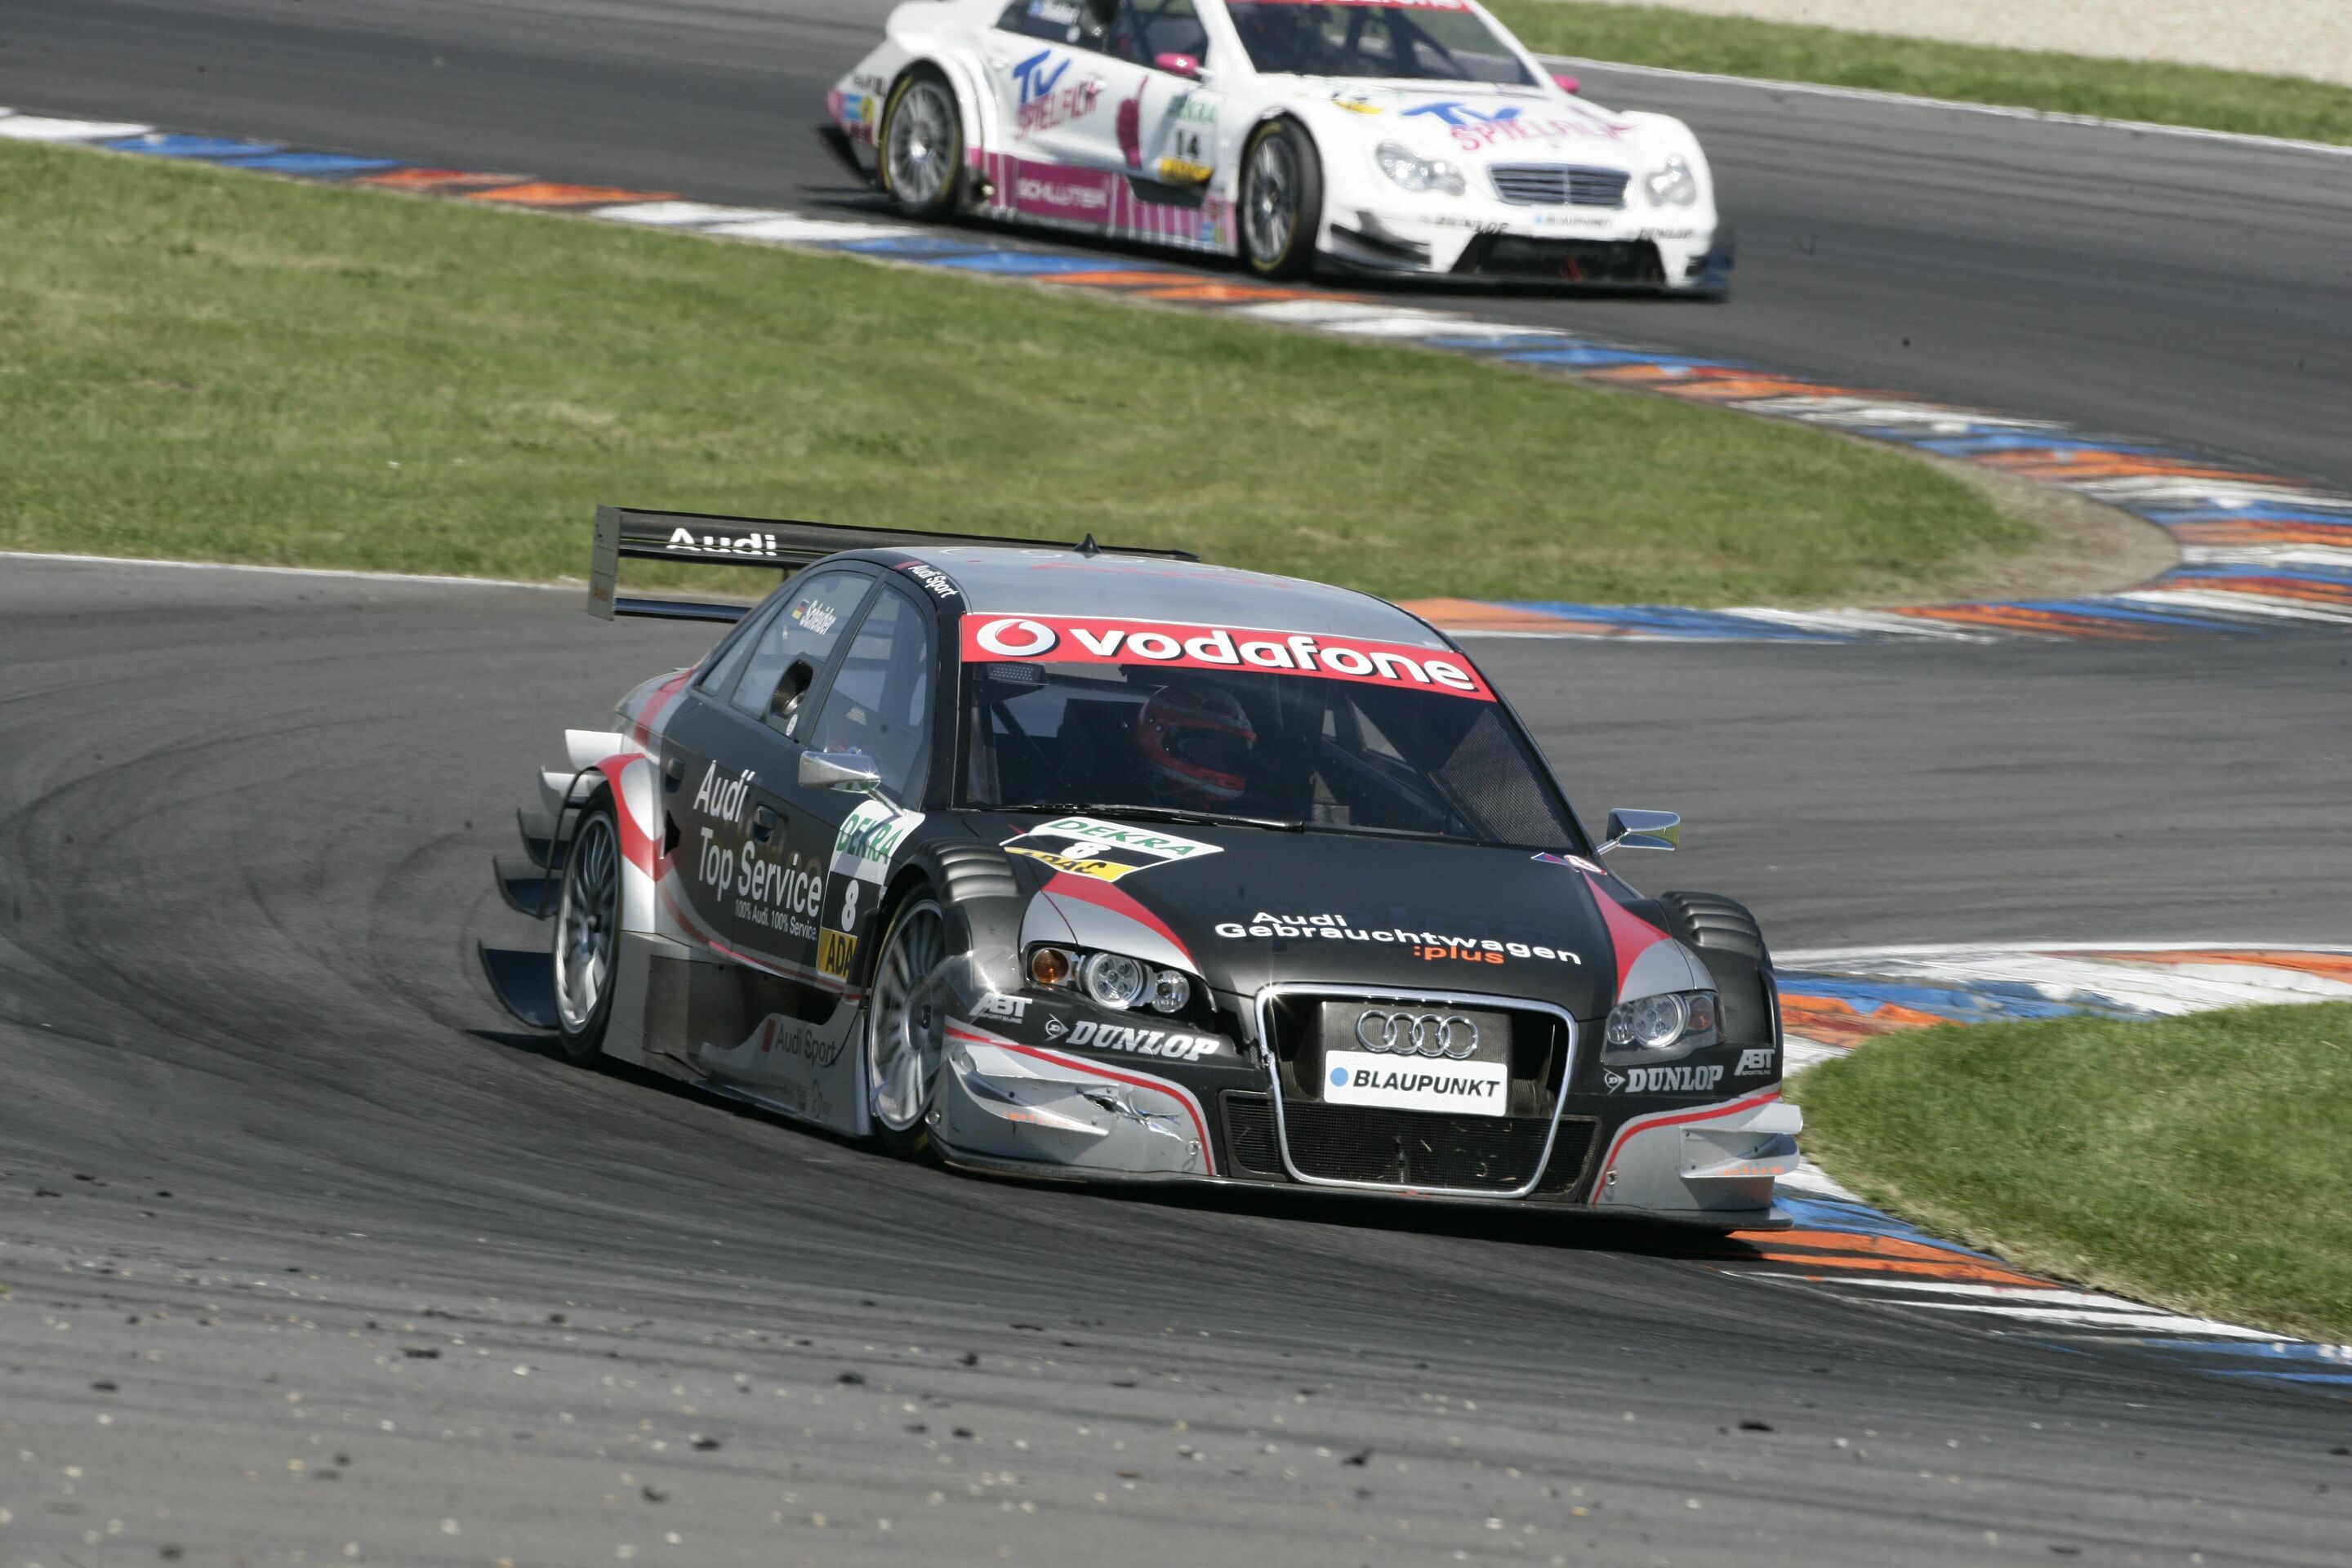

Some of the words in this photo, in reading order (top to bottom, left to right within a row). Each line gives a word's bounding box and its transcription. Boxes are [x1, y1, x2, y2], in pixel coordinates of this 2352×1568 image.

[1175, 131, 1199, 159] 14
[666, 528, 777, 556] Audi
[908, 564, 941, 579] Audi
[925, 575, 959, 599] Sport
[1068, 629, 1477, 691] vodafone
[693, 760, 755, 823] Audi
[836, 813, 904, 864] DEKRA
[1047, 820, 1196, 855] DEKRA
[698, 827, 736, 902] Top
[737, 840, 822, 918] Service
[771, 910, 789, 933] 100%
[841, 880, 859, 932] 8
[1253, 911, 1348, 927] Audi
[1215, 923, 1582, 965] Gebrauchtwagen
[969, 992, 1032, 1018] ABT
[775, 1024, 802, 1057] Audi
[804, 1029, 836, 1067] Sport
[1066, 1020, 1220, 1061] DUNLOP
[1624, 1065, 1724, 1093] DUNLOP
[1734, 1049, 1775, 1076] ABT
[1352, 1070, 1500, 1098] BLAUPUNKT
